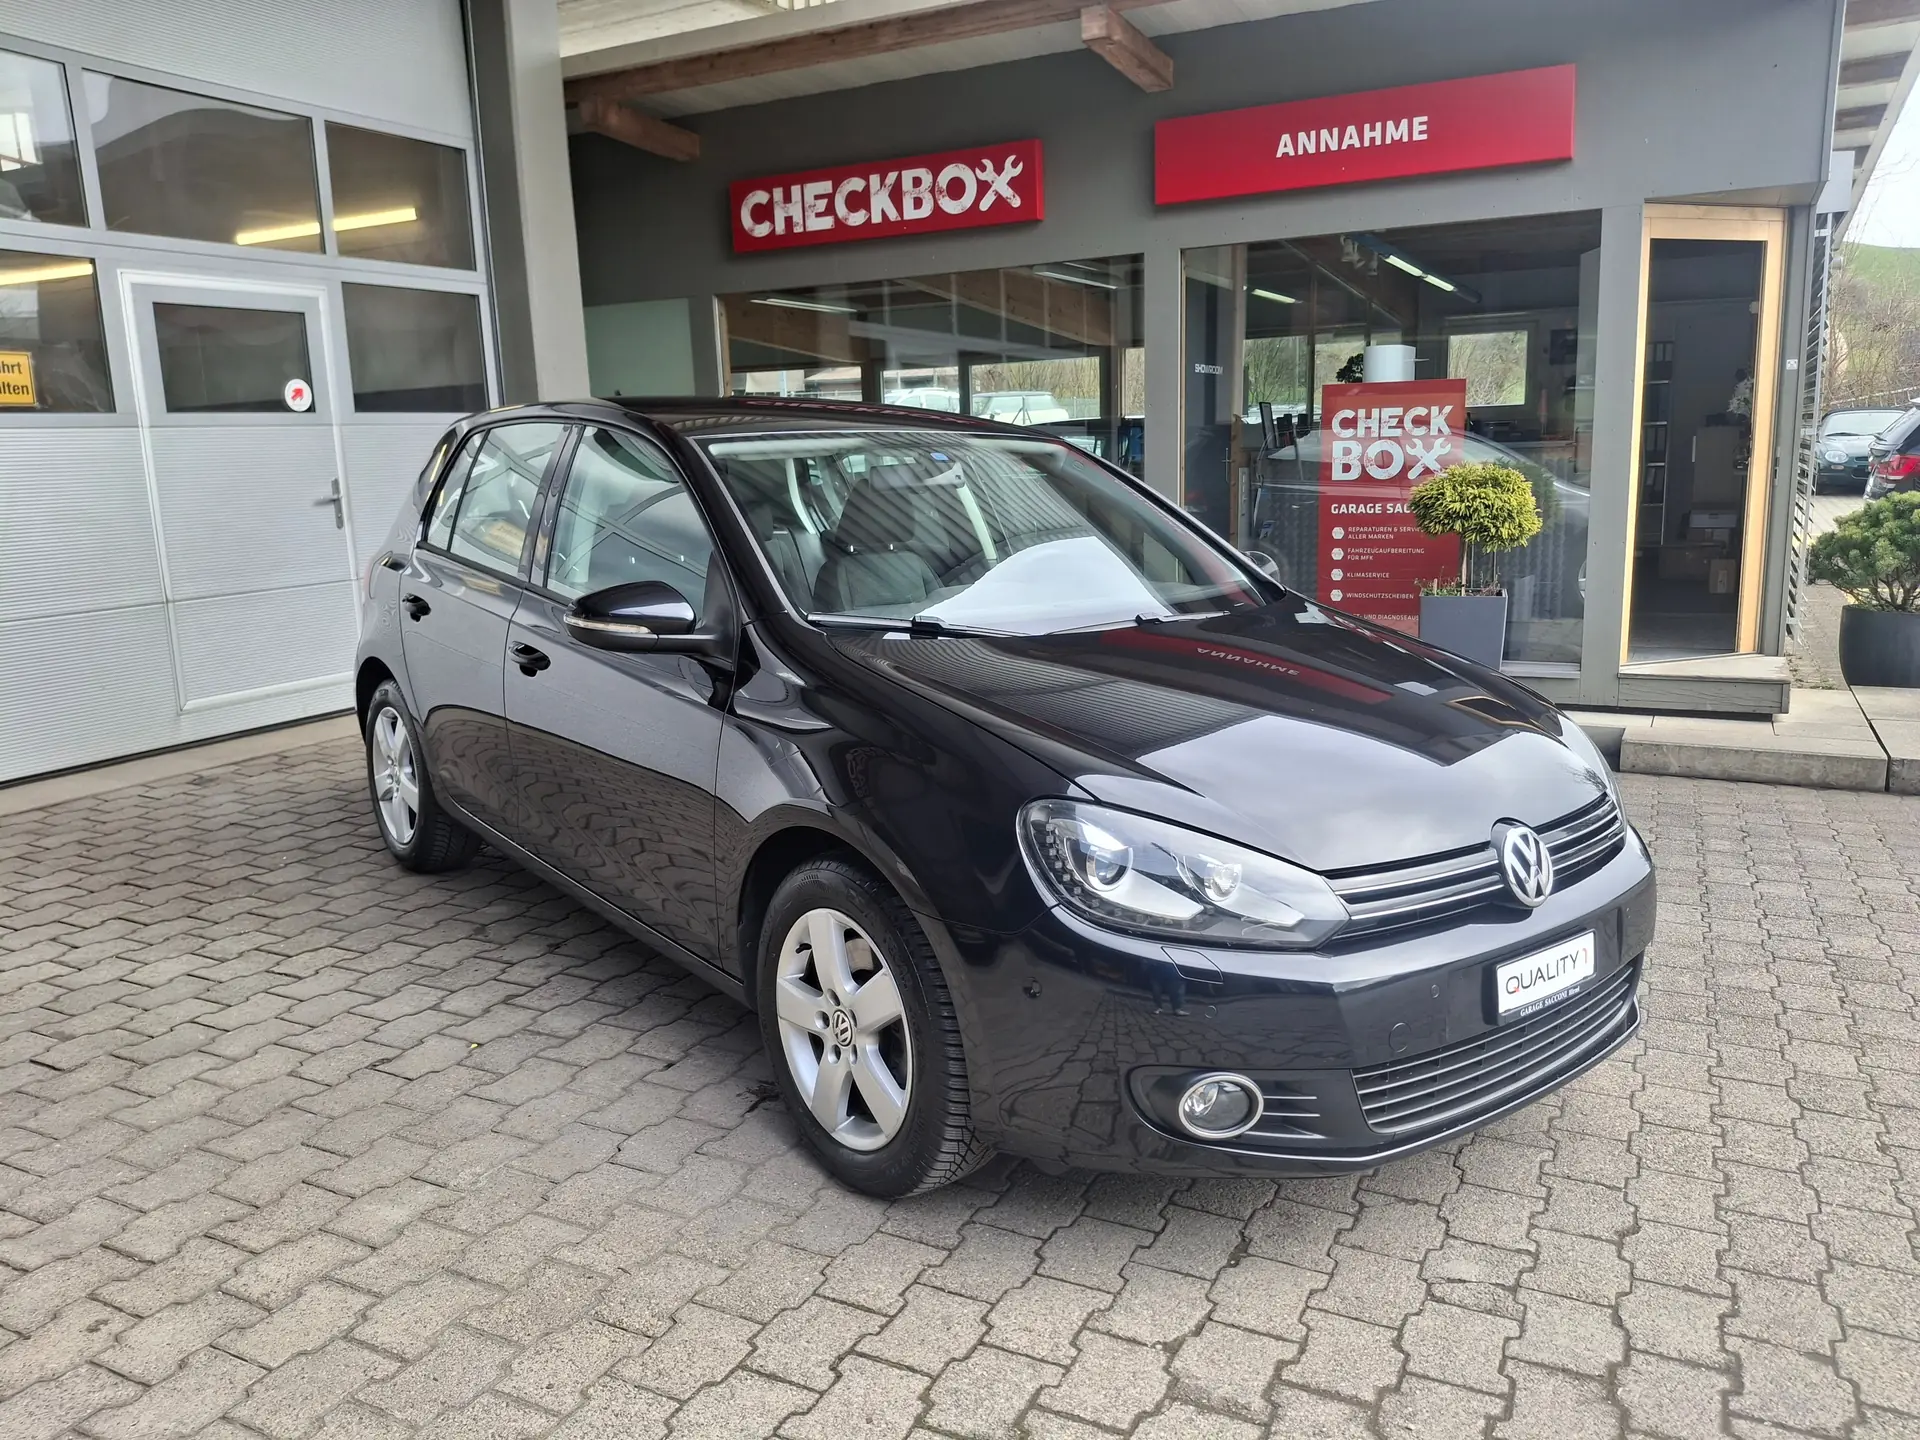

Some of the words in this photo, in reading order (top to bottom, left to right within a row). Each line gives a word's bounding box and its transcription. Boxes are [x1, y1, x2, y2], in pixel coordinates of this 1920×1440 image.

[1275, 115, 1428, 158] ANNAHME
[740, 154, 1023, 238] CHECKBOX
[0, 360, 22, 375] hrt
[1331, 405, 1454, 439] CHECK
[1331, 437, 1452, 480] BOX
[1330, 503, 1382, 514] GARAGE
[1386, 503, 1412, 514] SAC
[1347, 547, 1425, 555] FAHRZEUGAUFBEREITUNG
[1346, 592, 1414, 600] WINDSCHUTZSCHEIBEN
[1363, 613, 1377, 621] UND
[1378, 613, 1419, 621] DIAGNOSEAUS
[1505, 950, 1579, 995] QUALITY
[1582, 947, 1588, 965] 1
[1520, 1000, 1544, 1017] GARAGE
